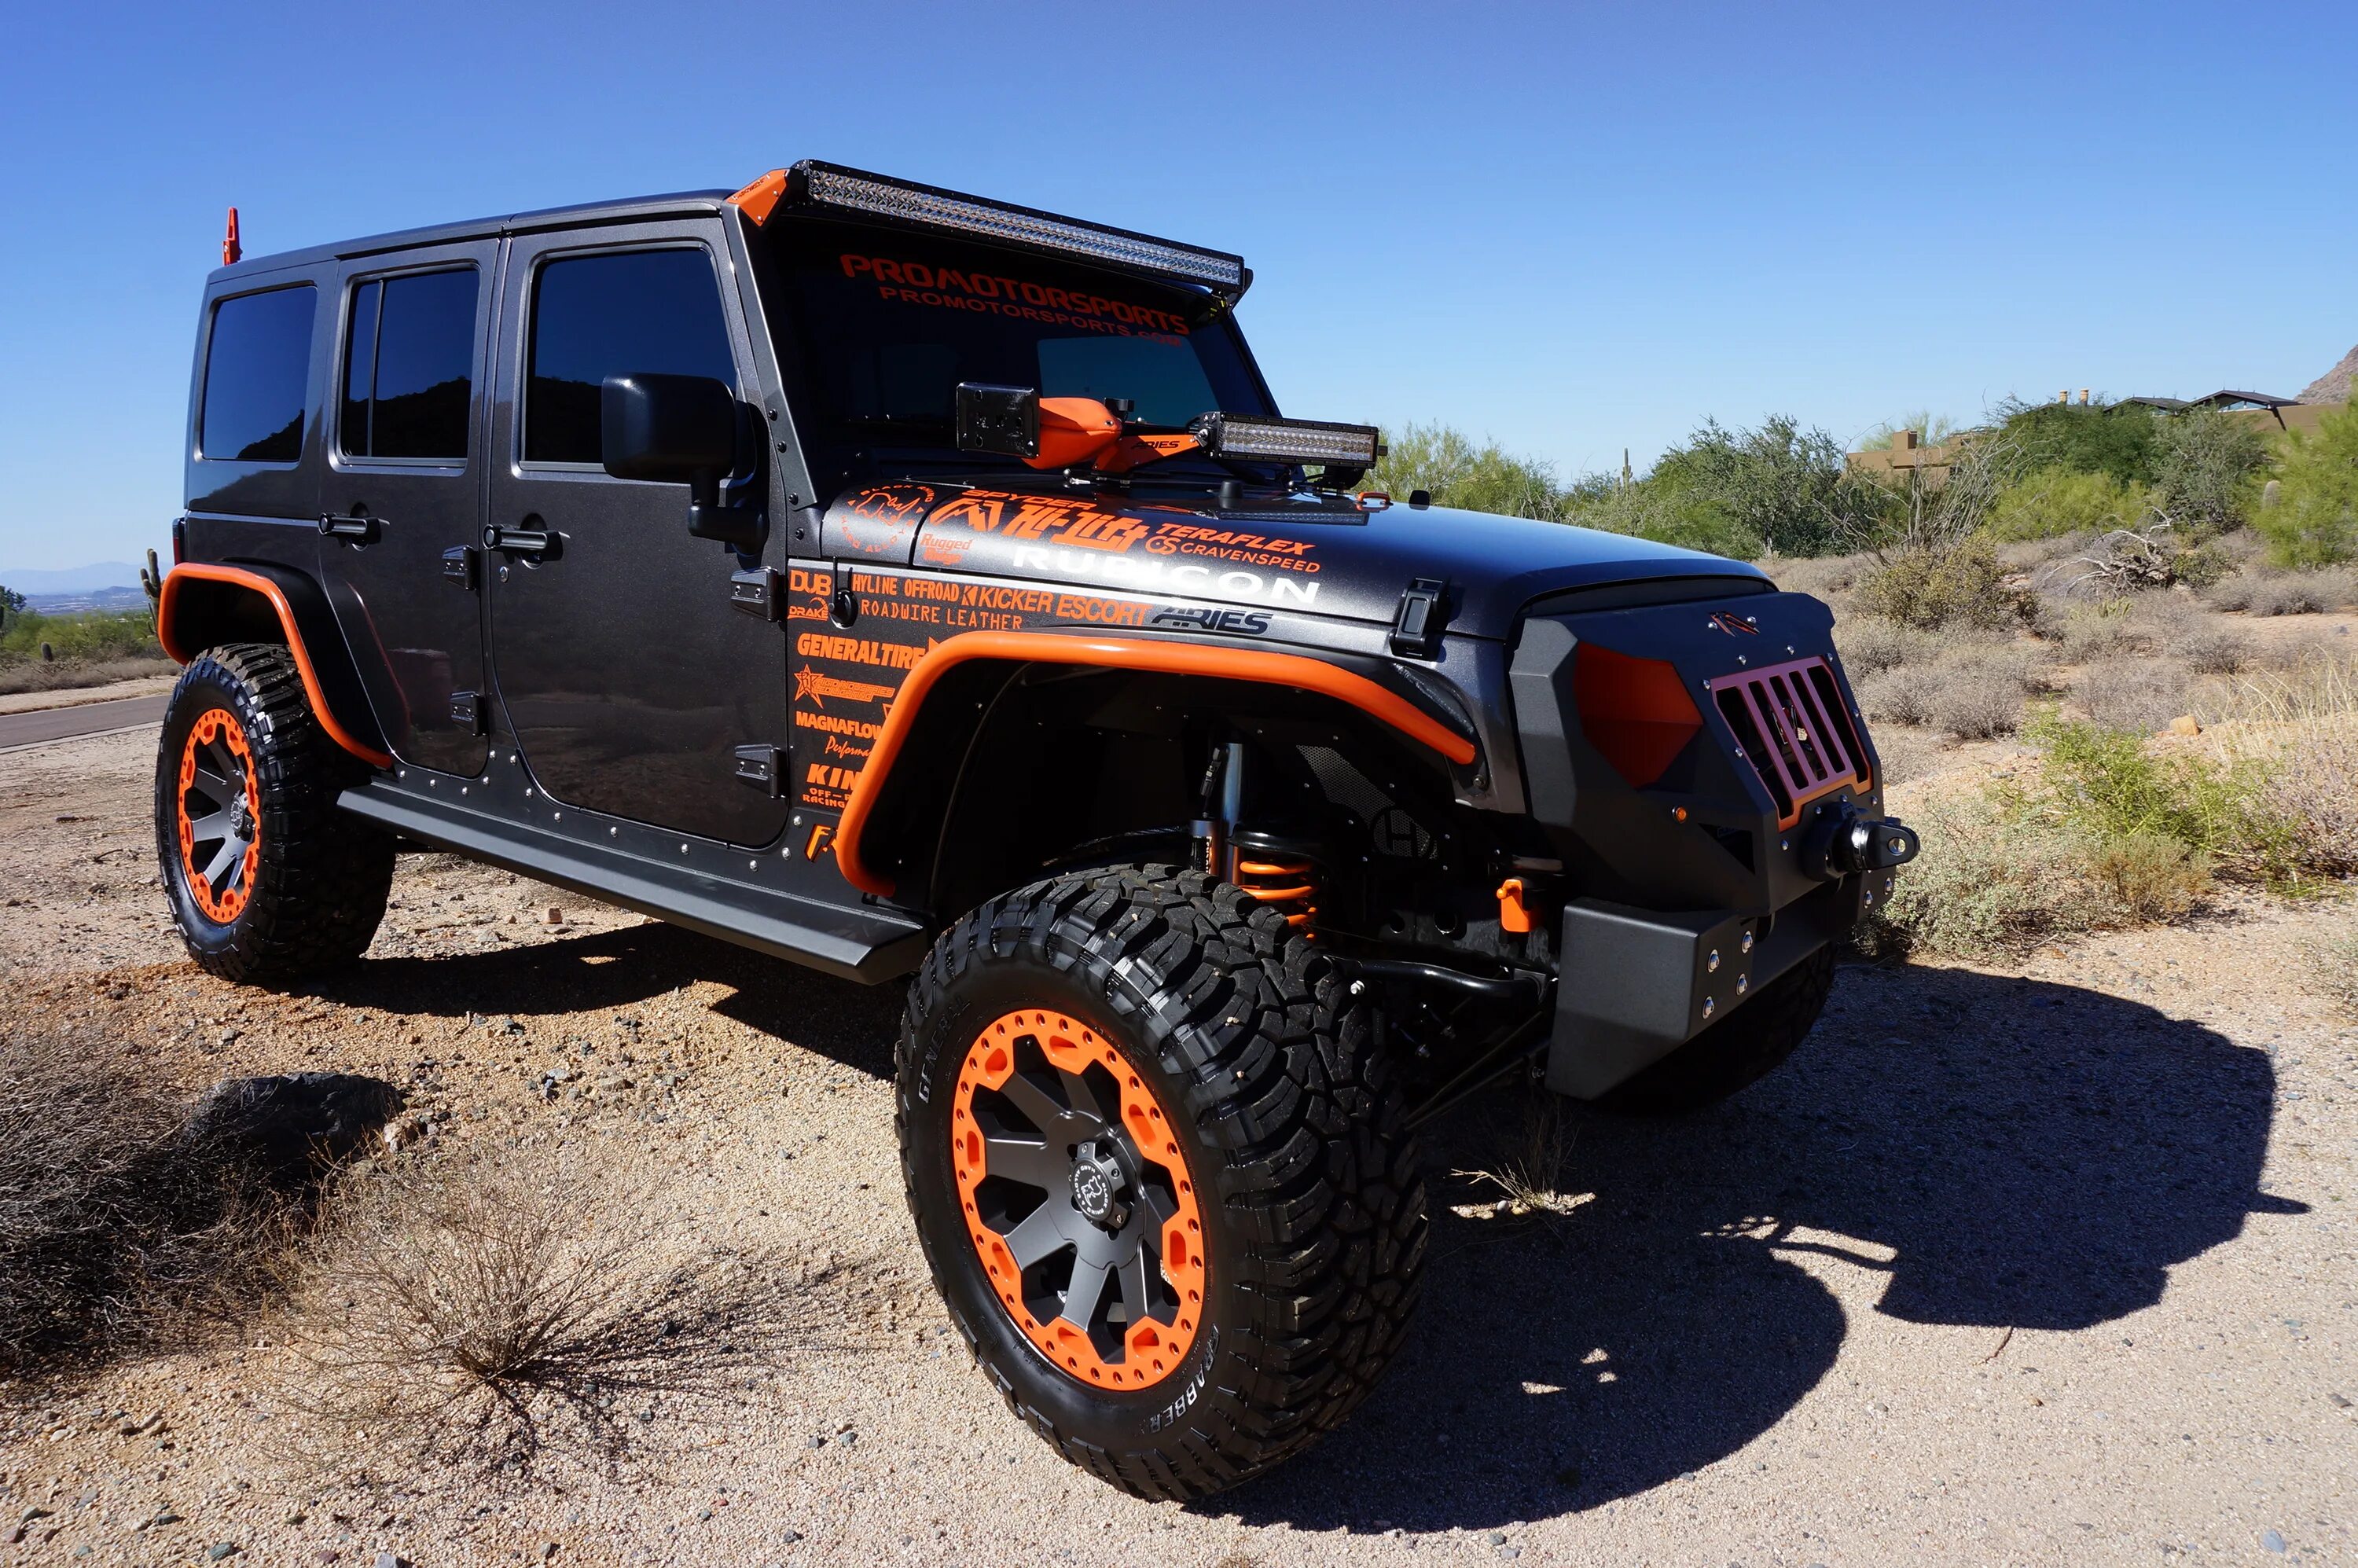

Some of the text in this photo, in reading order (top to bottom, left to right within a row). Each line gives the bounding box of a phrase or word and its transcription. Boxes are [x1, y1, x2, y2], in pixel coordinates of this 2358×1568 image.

[840, 254, 1189, 335] PROMOTORSPORTS
[962, 490, 1097, 510] SPYDER
[920, 533, 974, 551] Rugged
[1155, 523, 1317, 556] TERAFLEX
[1181, 542, 1321, 573] CRAVENSPEED
[790, 570, 832, 596] DUB
[853, 573, 960, 603] HYLINE OFFROAD
[1013, 545, 1320, 604] RUBICON
[789, 605, 828, 619] DRAKE
[861, 599, 1023, 629] ROADWIRE LEATHER
[979, 586, 1054, 613] KICKER
[1056, 593, 1155, 626] ESCORT
[1151, 606, 1274, 635] ARIES
[825, 735, 872, 758] Performa
[806, 763, 861, 791] KIN
[803, 795, 845, 809] RACING
[1150, 1323, 1221, 1434] GRABBER
